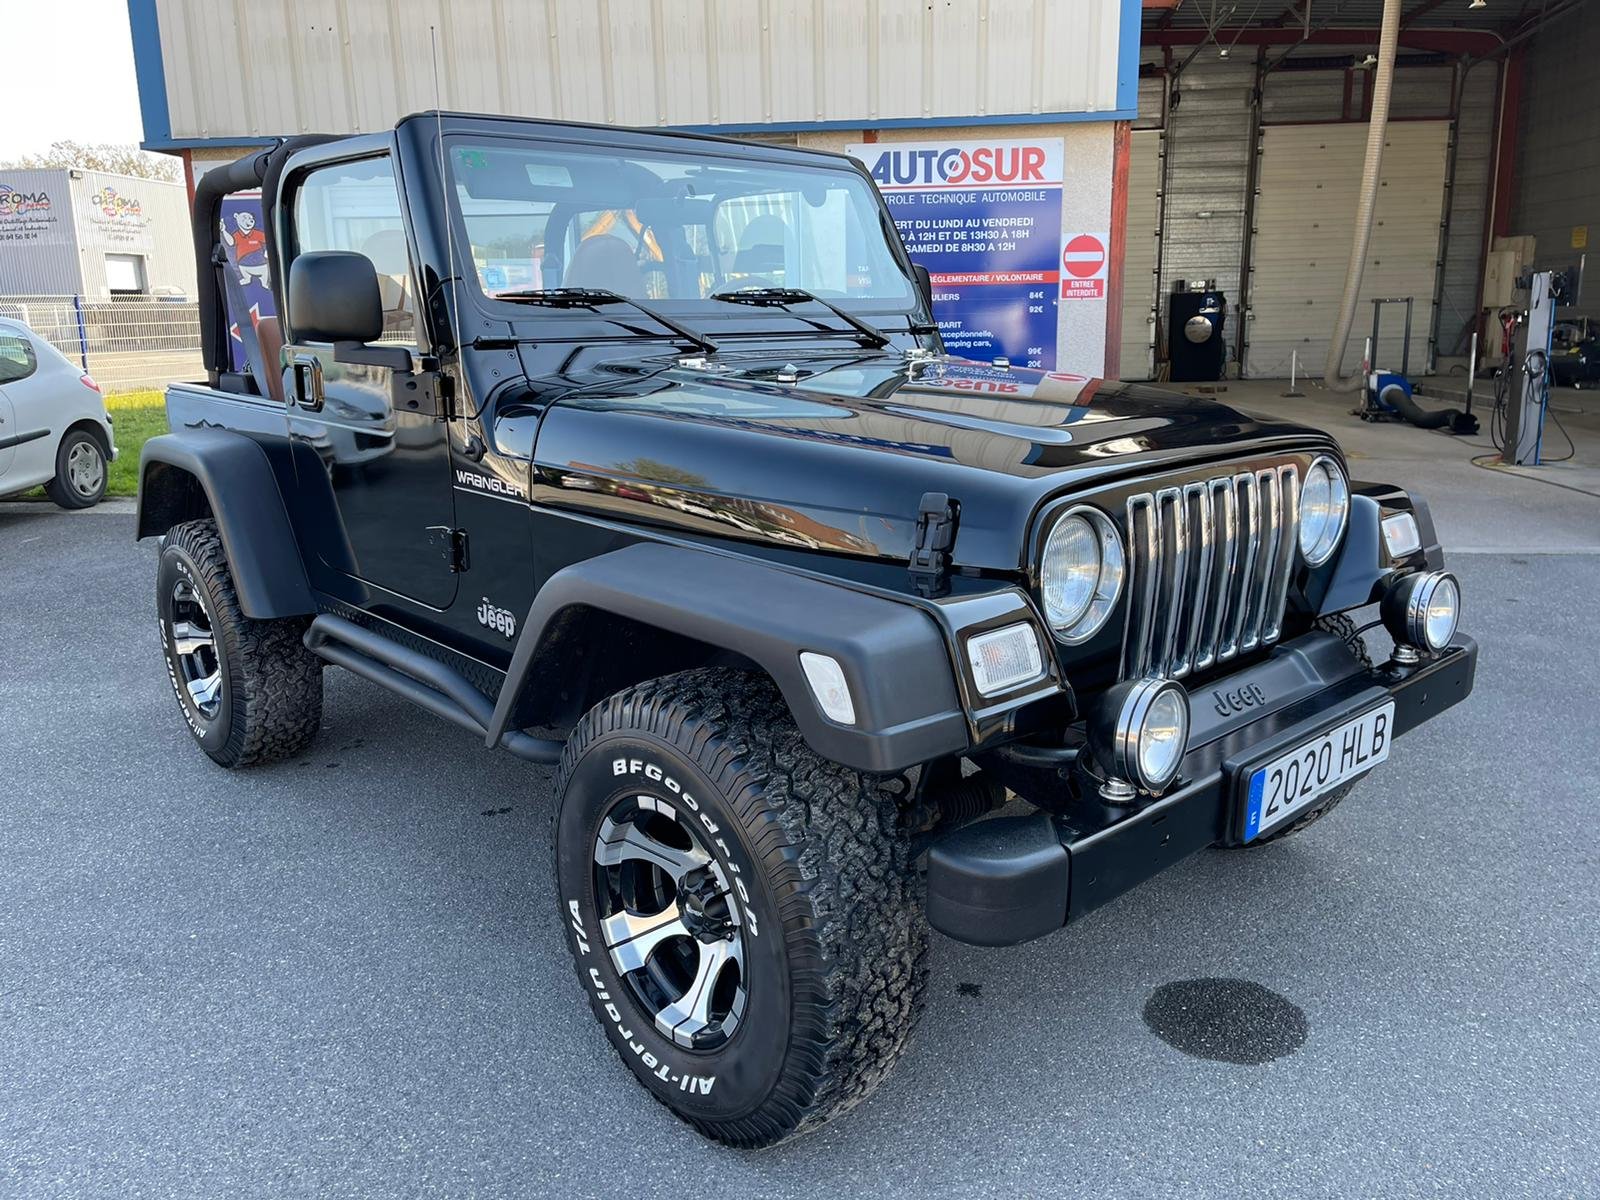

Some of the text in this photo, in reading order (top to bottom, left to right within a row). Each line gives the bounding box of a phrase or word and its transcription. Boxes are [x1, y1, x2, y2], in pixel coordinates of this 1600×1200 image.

[870, 147, 1046, 184] AUTOSUR
[920, 192, 976, 205] TECHNIQUE
[981, 191, 1046, 202] AUTOMOBILE
[915, 220, 931, 229] DU
[932, 219, 963, 228] LUNDI
[965, 218, 980, 228] AU
[983, 217, 1034, 228] VENDREDI
[918, 232, 936, 241] 12H
[938, 231, 951, 240] ET
[953, 231, 967, 240] DE
[970, 230, 999, 240] 13H30
[1011, 229, 1030, 239] 18H
[905, 244, 943, 253] SAMEDI
[945, 243, 959, 252] DE
[961, 243, 986, 252] 8H30
[998, 241, 1016, 251] 12H
[996, 273, 1043, 281] VOLONTAIRE
[1029, 291, 1044, 299] 84€
[1066, 289, 1099, 297] INTERDITE
[1029, 305, 1043, 313] 92€
[936, 321, 962, 329] BARIT
[456, 469, 524, 497] WRANGLER
[477, 600, 516, 637] Jeep
[1212, 682, 1266, 717] Jeep
[1265, 741, 1332, 818] 2020
[1340, 713, 1387, 774] HLB
[612, 758, 758, 937] BFGoodrich
[568, 899, 716, 1095] All-Terrain T/A
